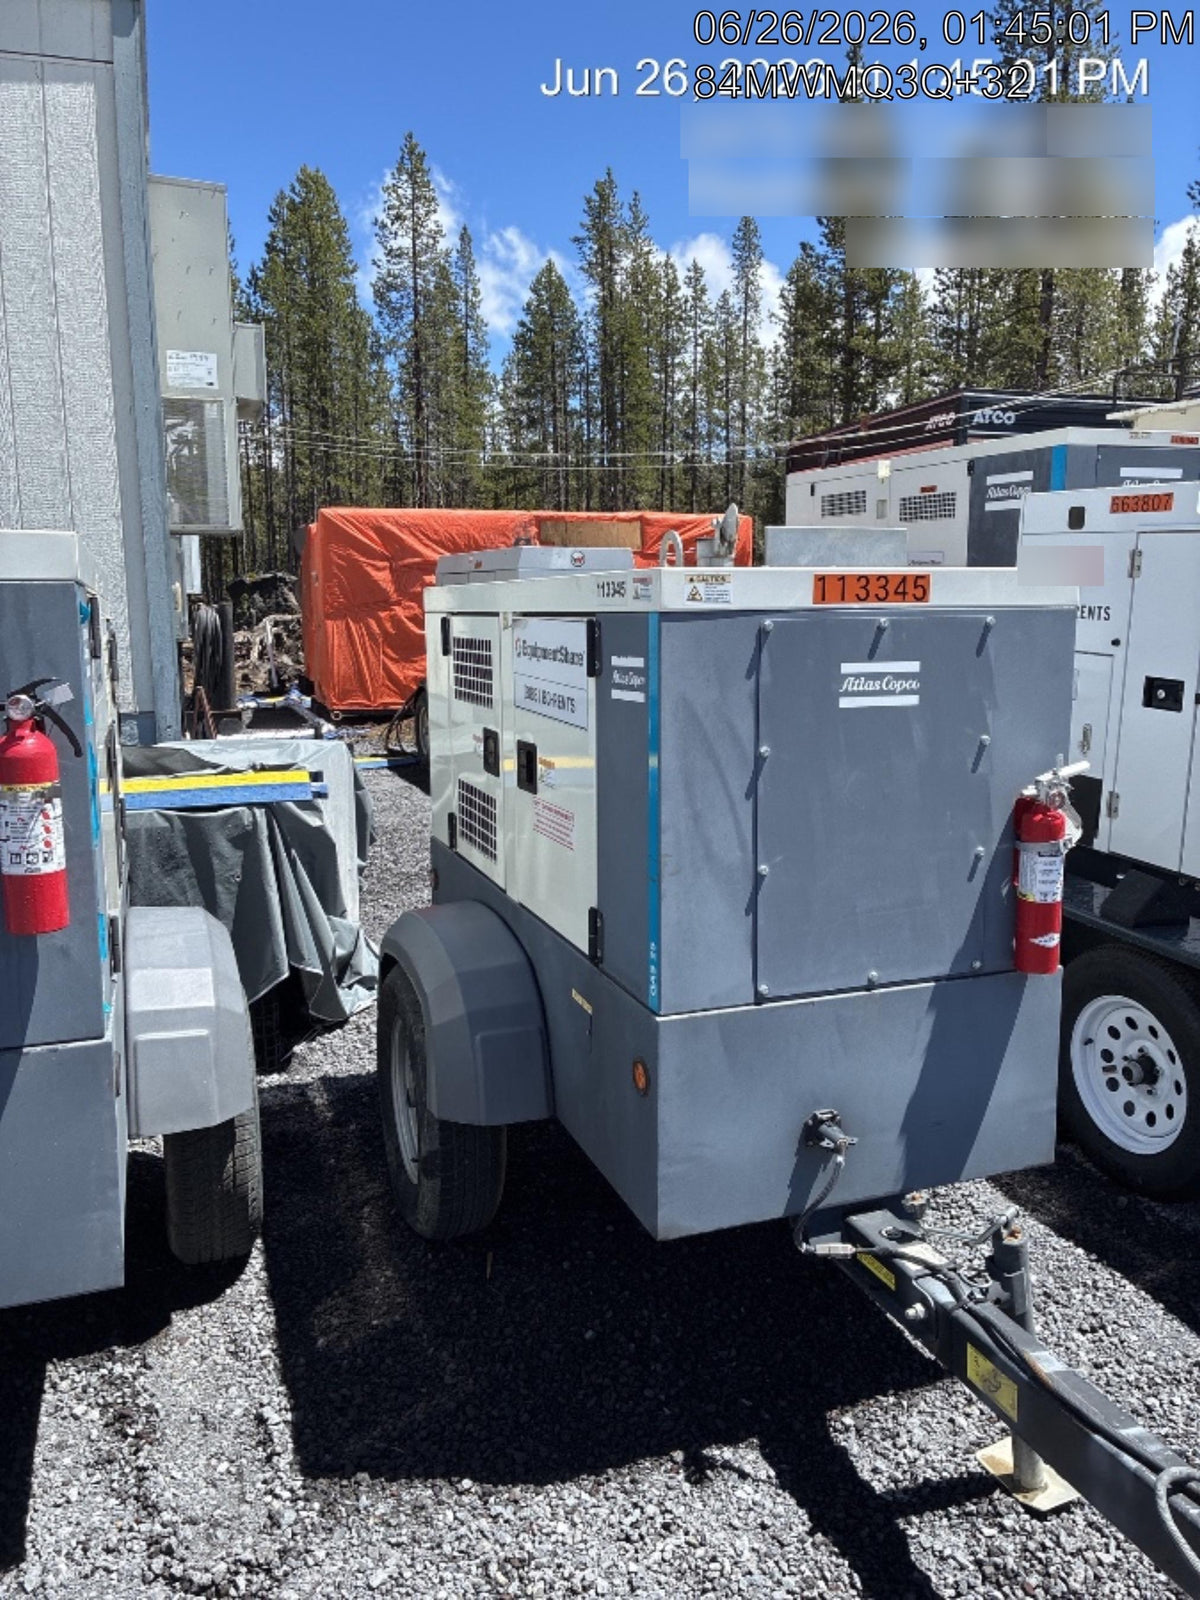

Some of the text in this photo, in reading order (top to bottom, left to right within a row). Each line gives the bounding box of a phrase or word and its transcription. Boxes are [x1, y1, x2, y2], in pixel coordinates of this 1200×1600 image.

[972, 409, 1016, 425] ATCO
[817, 575, 927, 602] 113345
[839, 675, 920, 694] Atlas Copco
